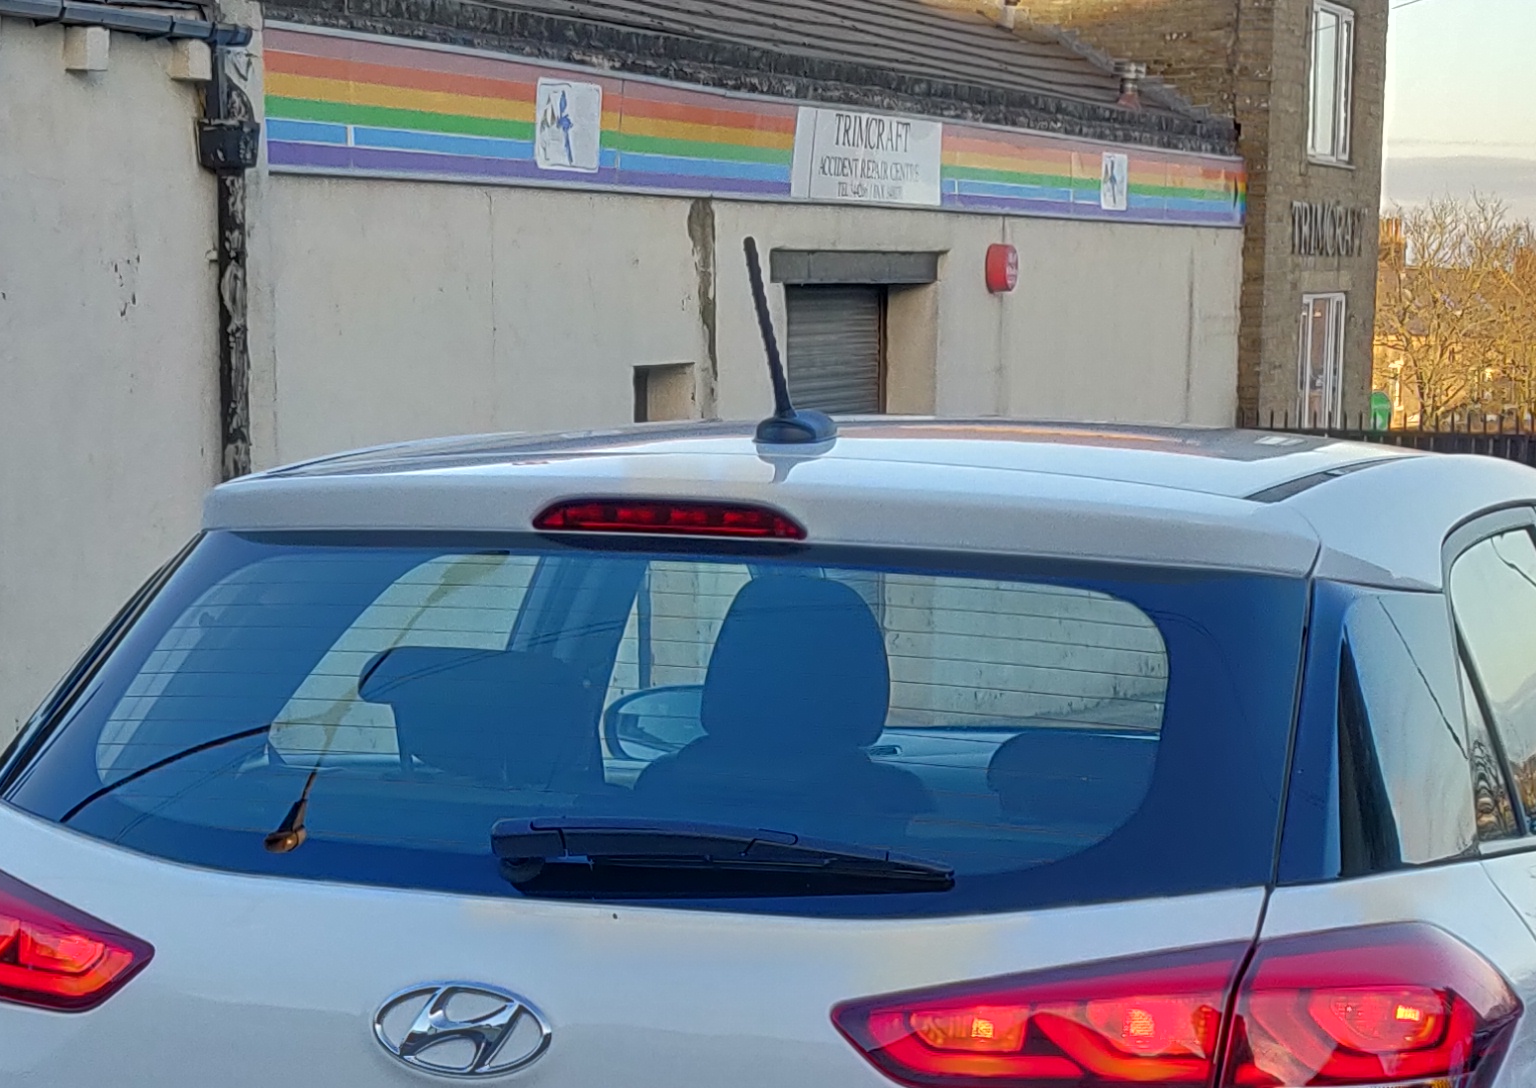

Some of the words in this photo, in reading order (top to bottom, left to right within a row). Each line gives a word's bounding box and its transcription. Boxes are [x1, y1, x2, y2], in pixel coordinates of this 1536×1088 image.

[835, 113, 910, 152] TRIMCRAFT
[818, 155, 859, 178] ACCIDENT
[860, 158, 889, 181] REPAIR
